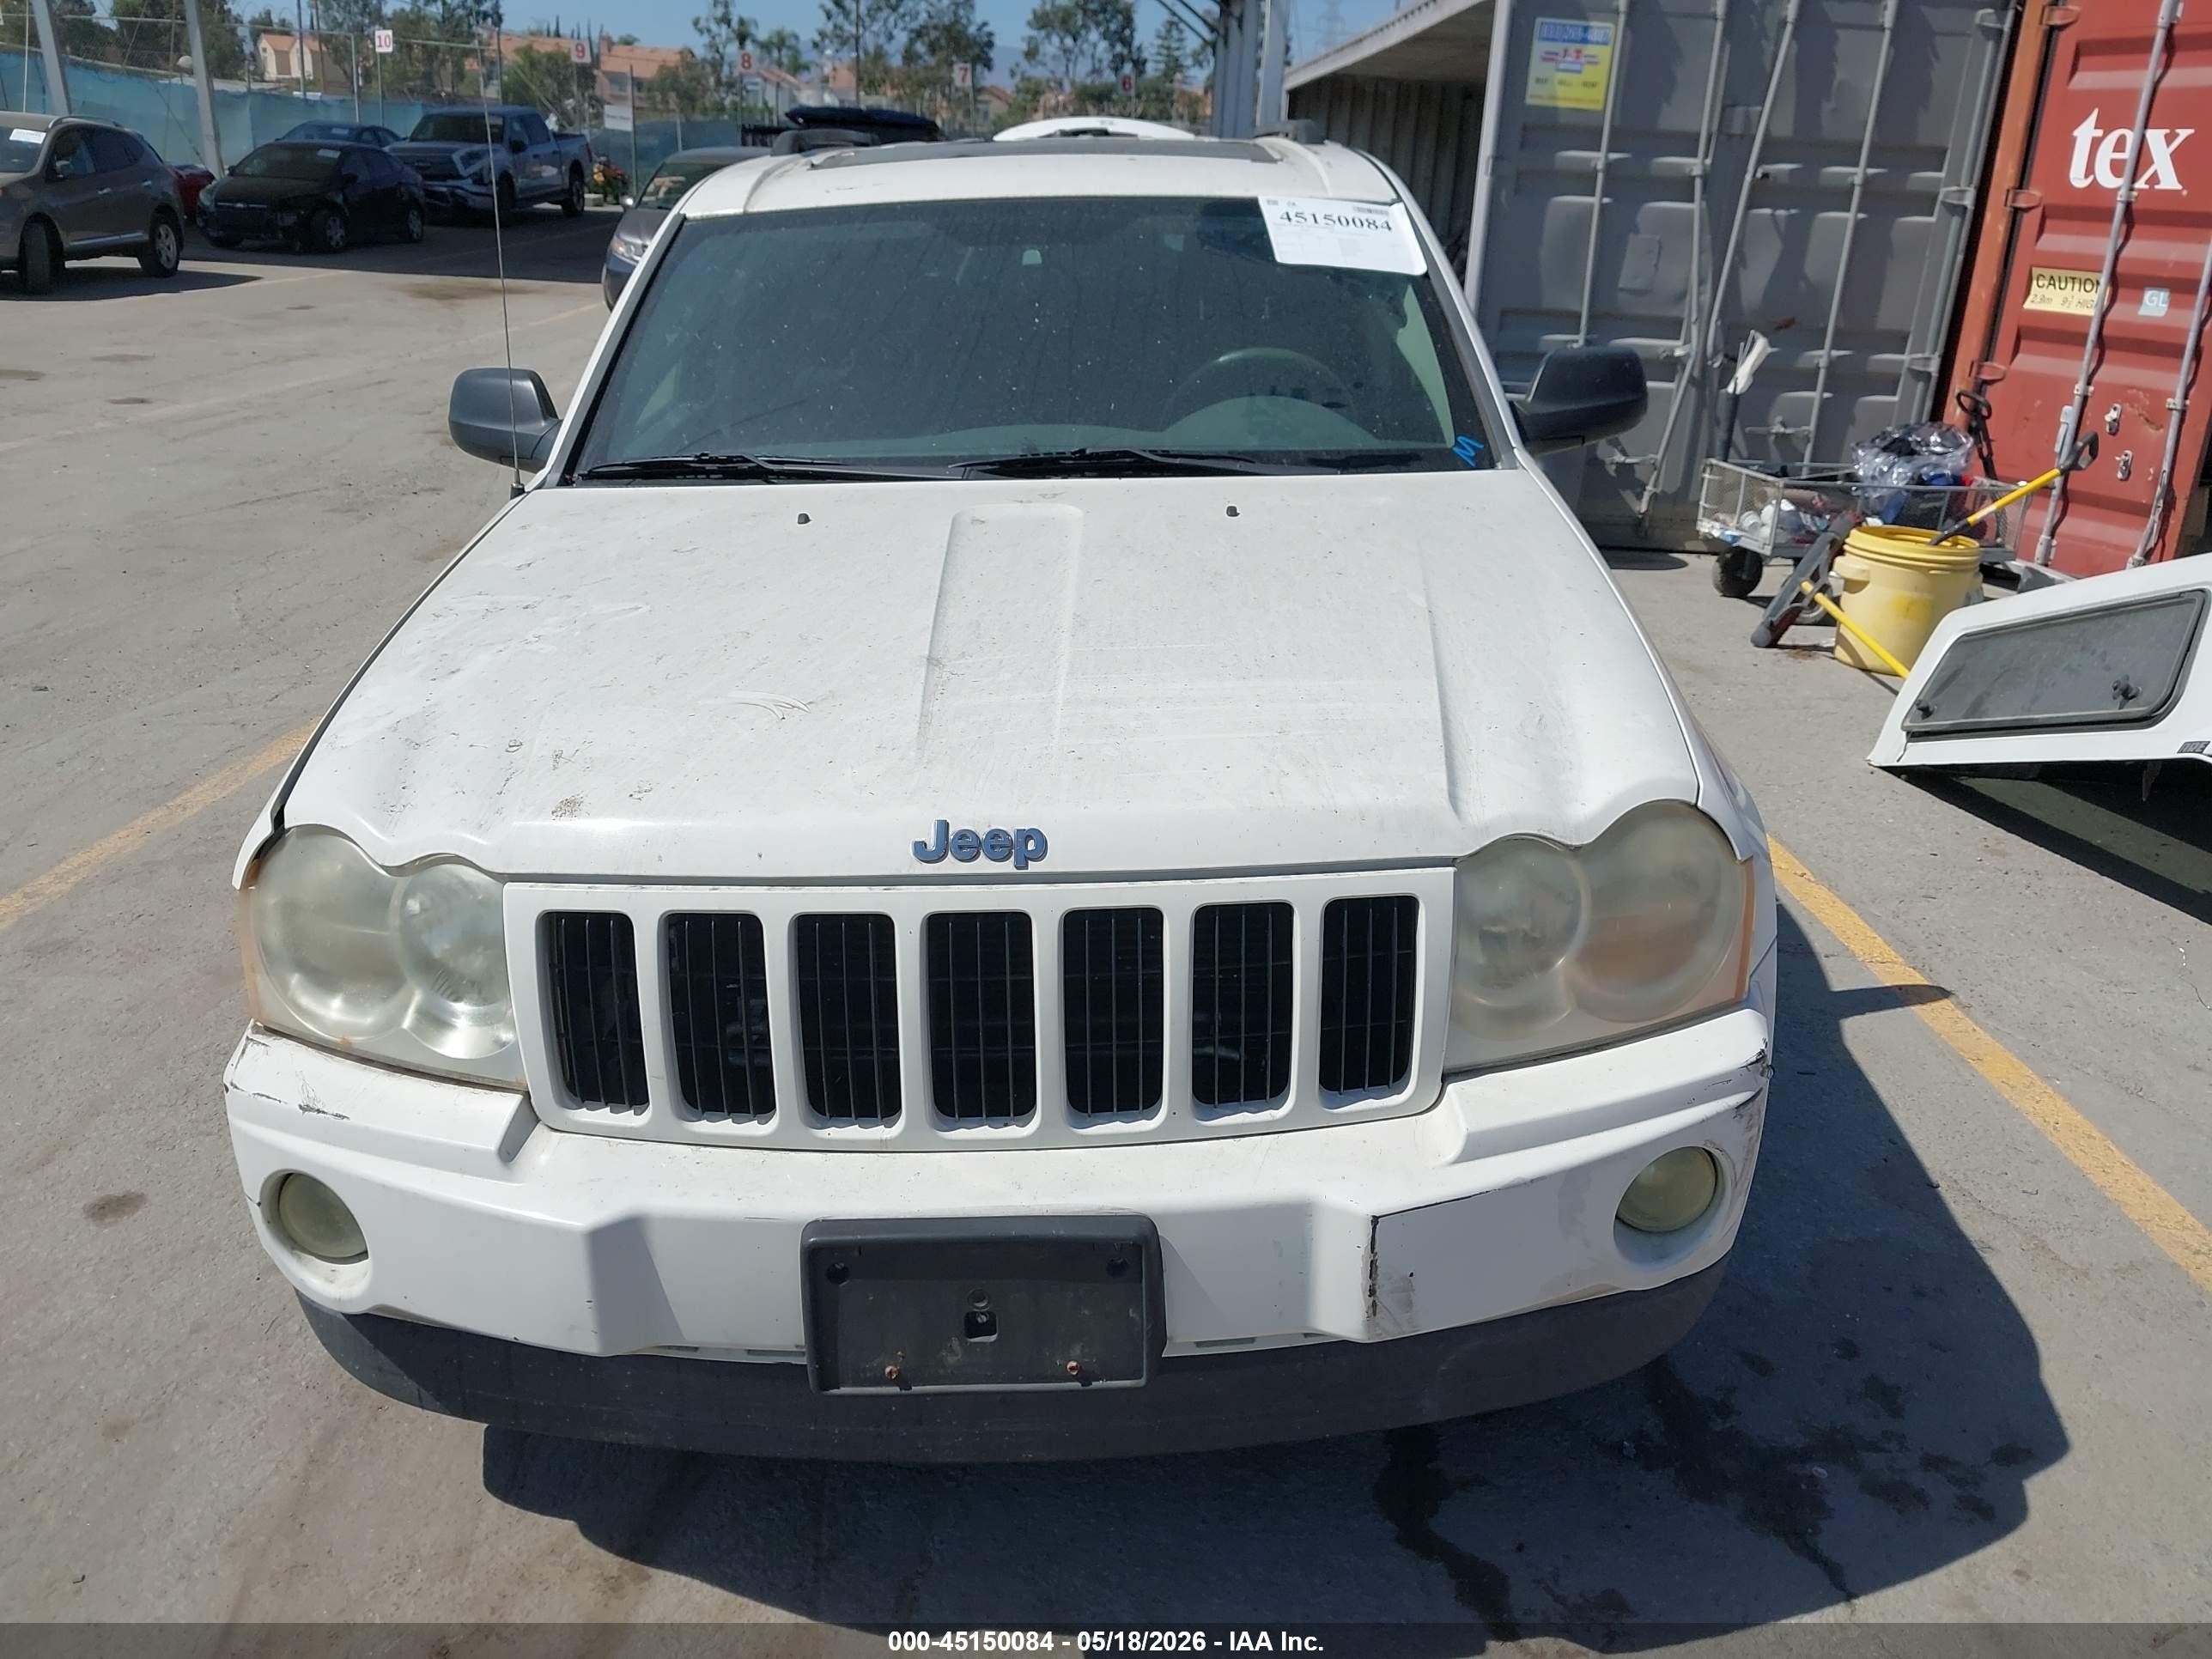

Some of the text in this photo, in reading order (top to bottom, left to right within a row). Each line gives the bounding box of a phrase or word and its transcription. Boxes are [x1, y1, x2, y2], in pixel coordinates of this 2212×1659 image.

[377, 34, 392, 48] 10
[575, 43, 585, 59] 9
[741, 53, 751, 70] 8
[959, 66, 969, 83] 7
[1121, 76, 1132, 91] 6
[2069, 108, 2195, 190] tex
[1279, 210, 1393, 232] 45150084
[2075, 299, 2095, 310] HIG
[2145, 291, 2169, 307] GL
[912, 819, 1048, 870] Jeep
